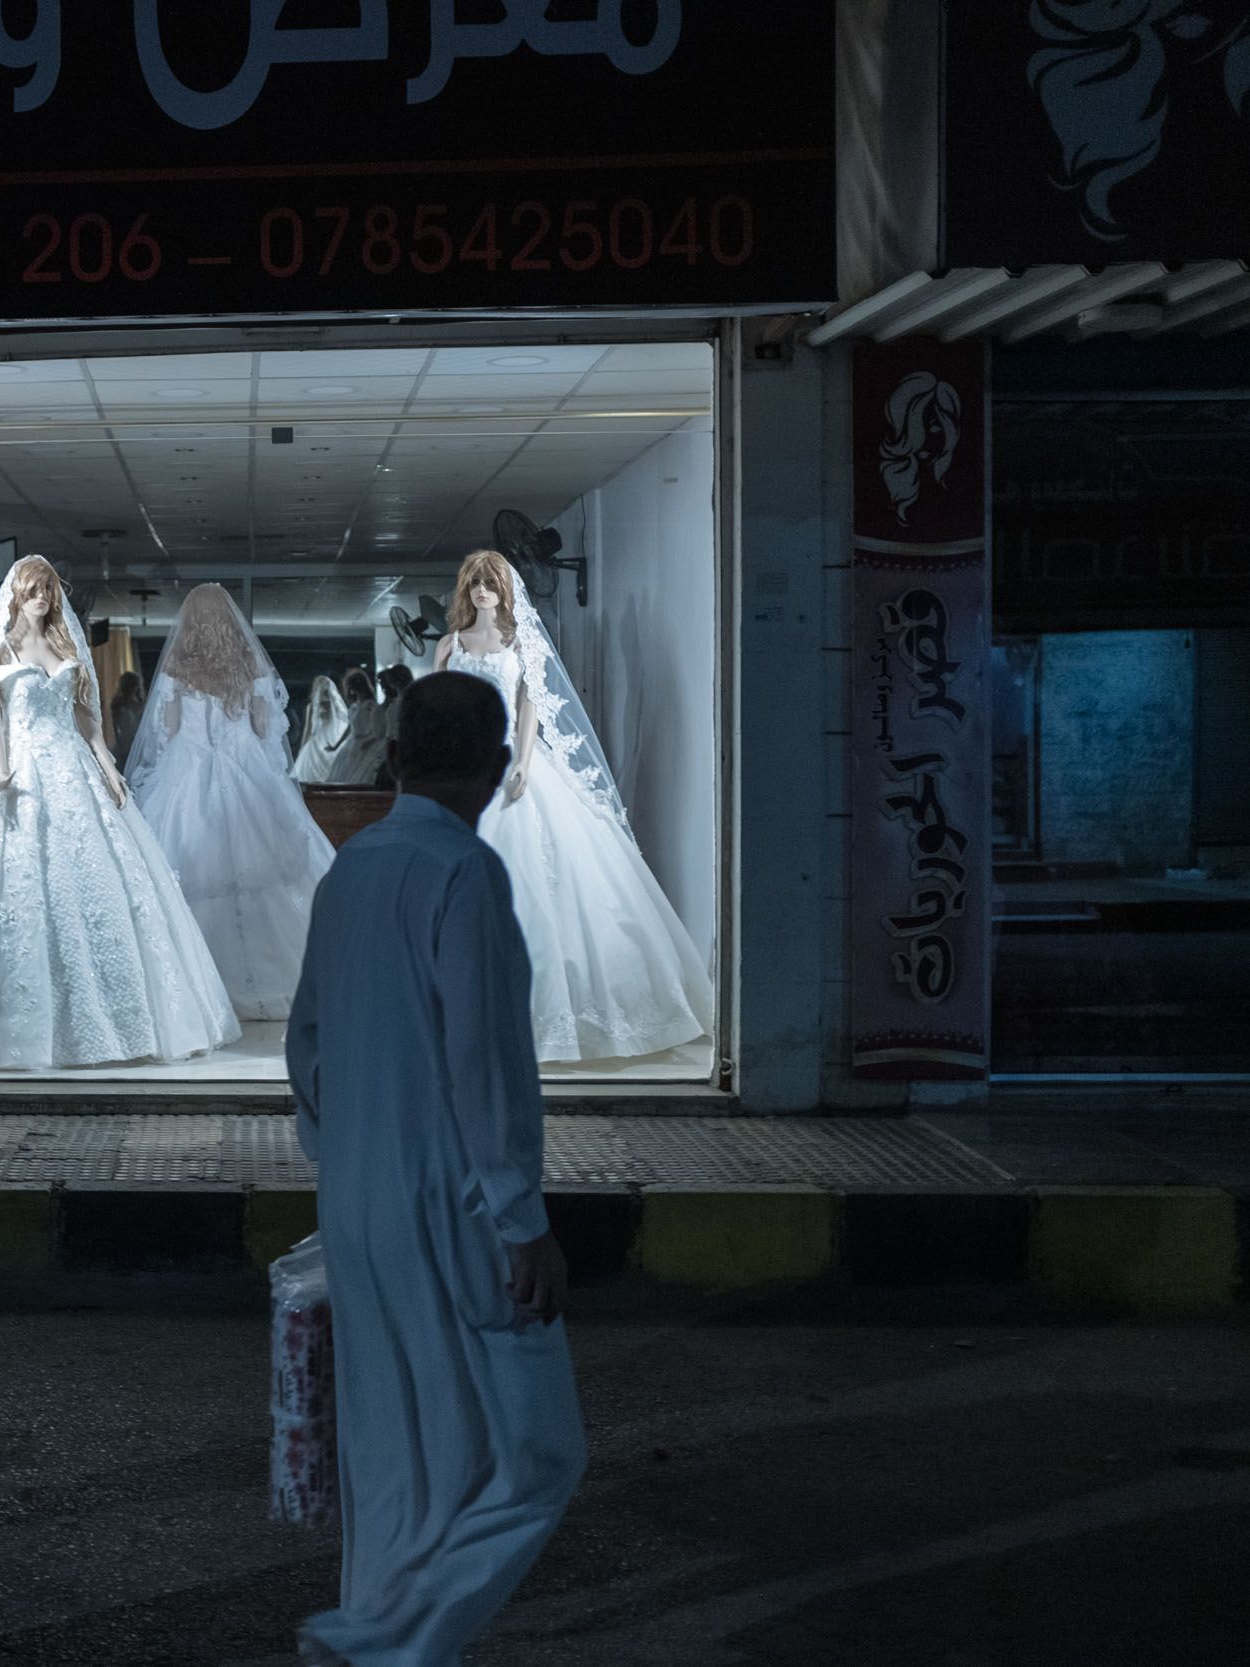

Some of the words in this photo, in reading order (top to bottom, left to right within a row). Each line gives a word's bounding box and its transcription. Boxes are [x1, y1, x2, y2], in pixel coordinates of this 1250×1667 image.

[258, 195, 755, 280] 0785425040
[883, 586, 966, 724] قصر
[882, 751, 968, 1000] الحوريات
